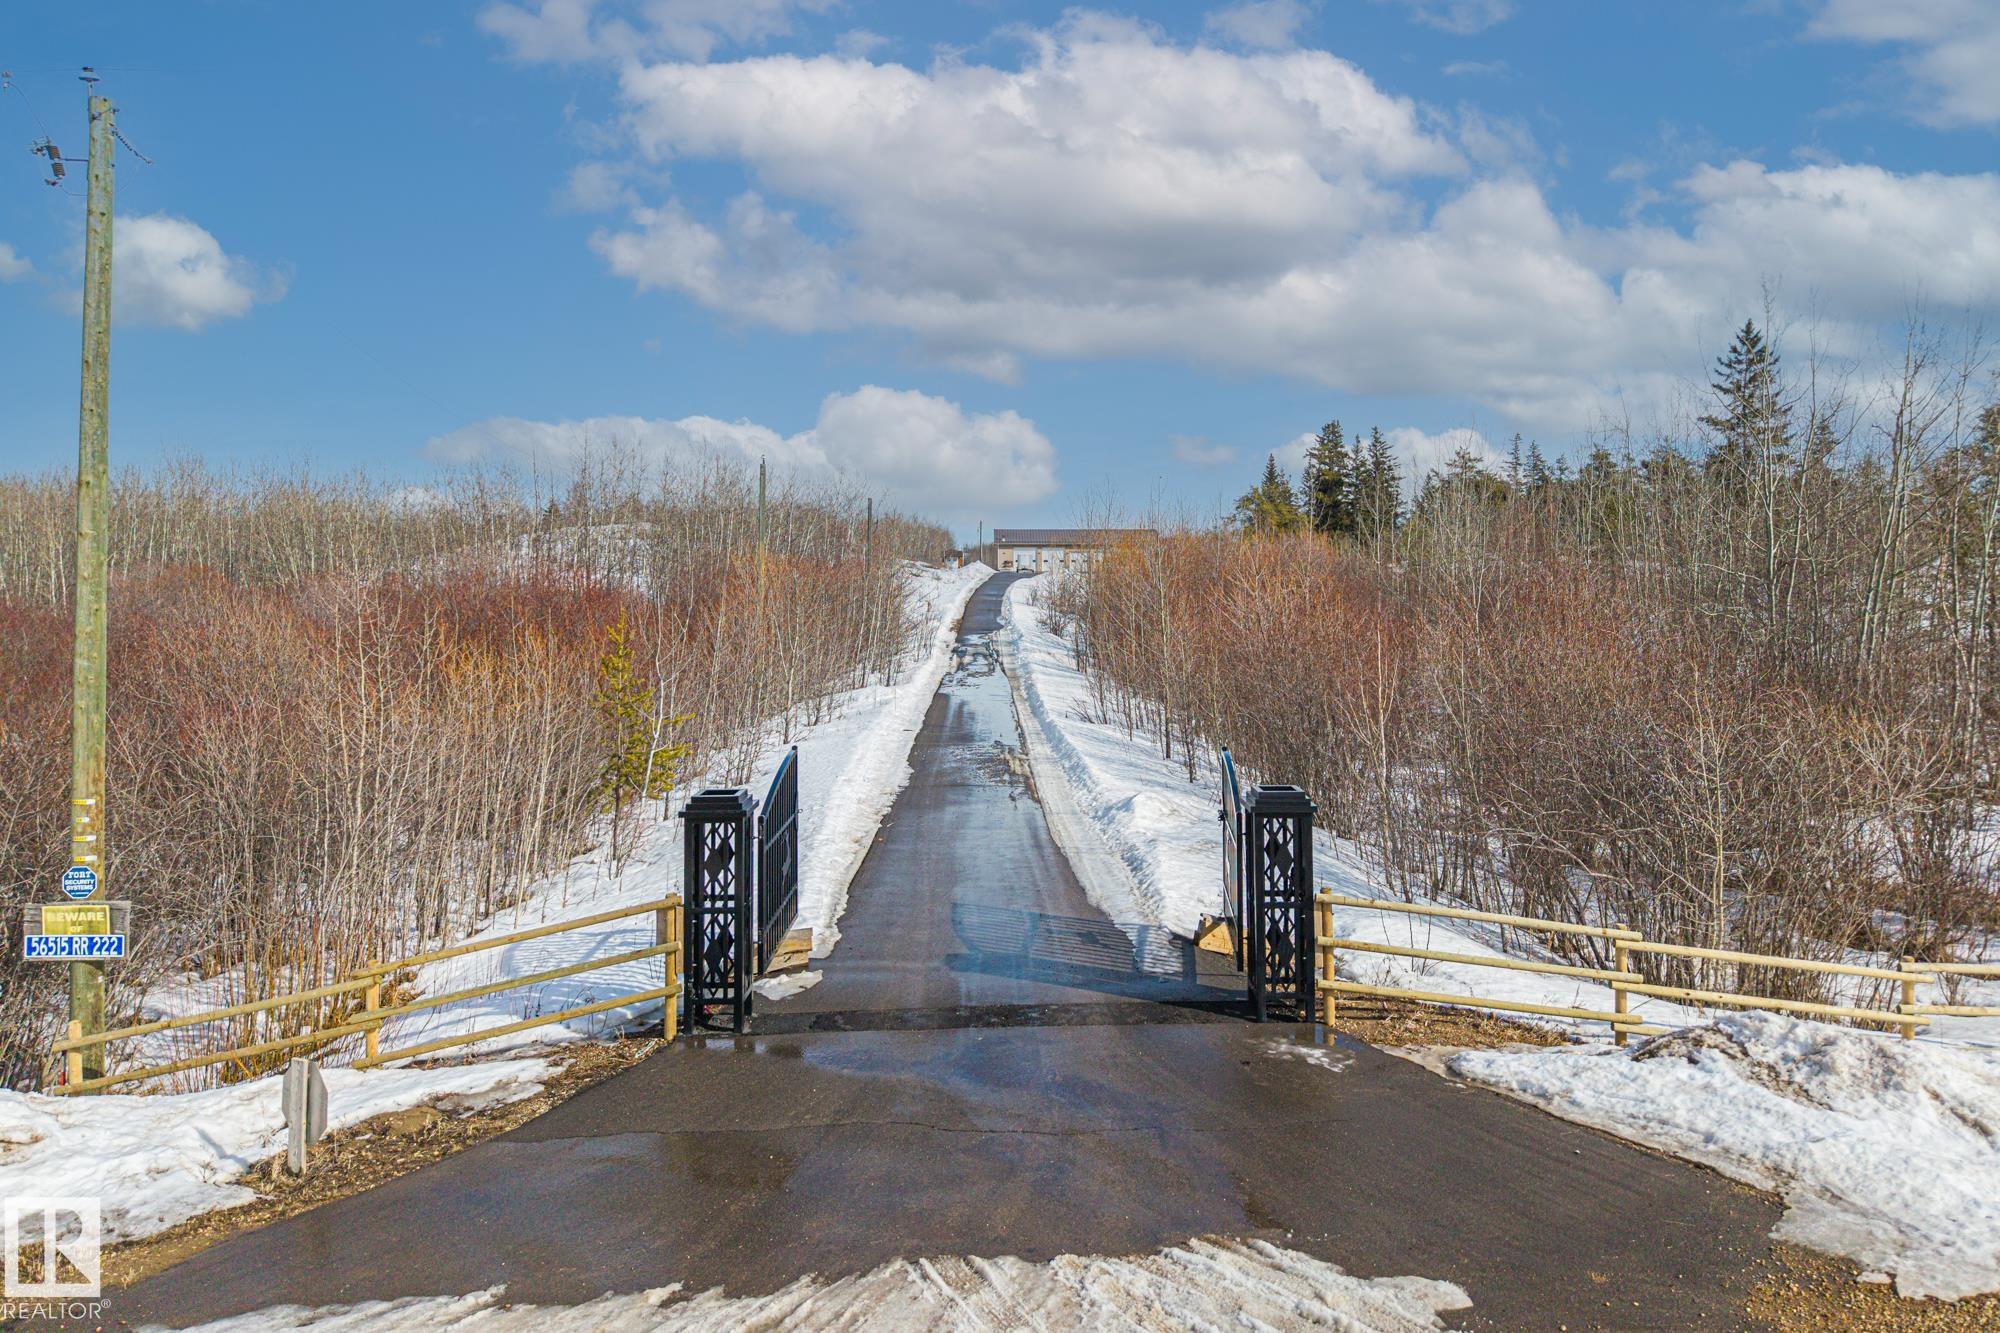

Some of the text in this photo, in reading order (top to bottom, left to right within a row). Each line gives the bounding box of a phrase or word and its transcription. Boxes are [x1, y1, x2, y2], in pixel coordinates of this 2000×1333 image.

[68, 871, 91, 879] FORT
[46, 911, 105, 922] BEWARE
[31, 937, 118, 956] 56515 RR 222
